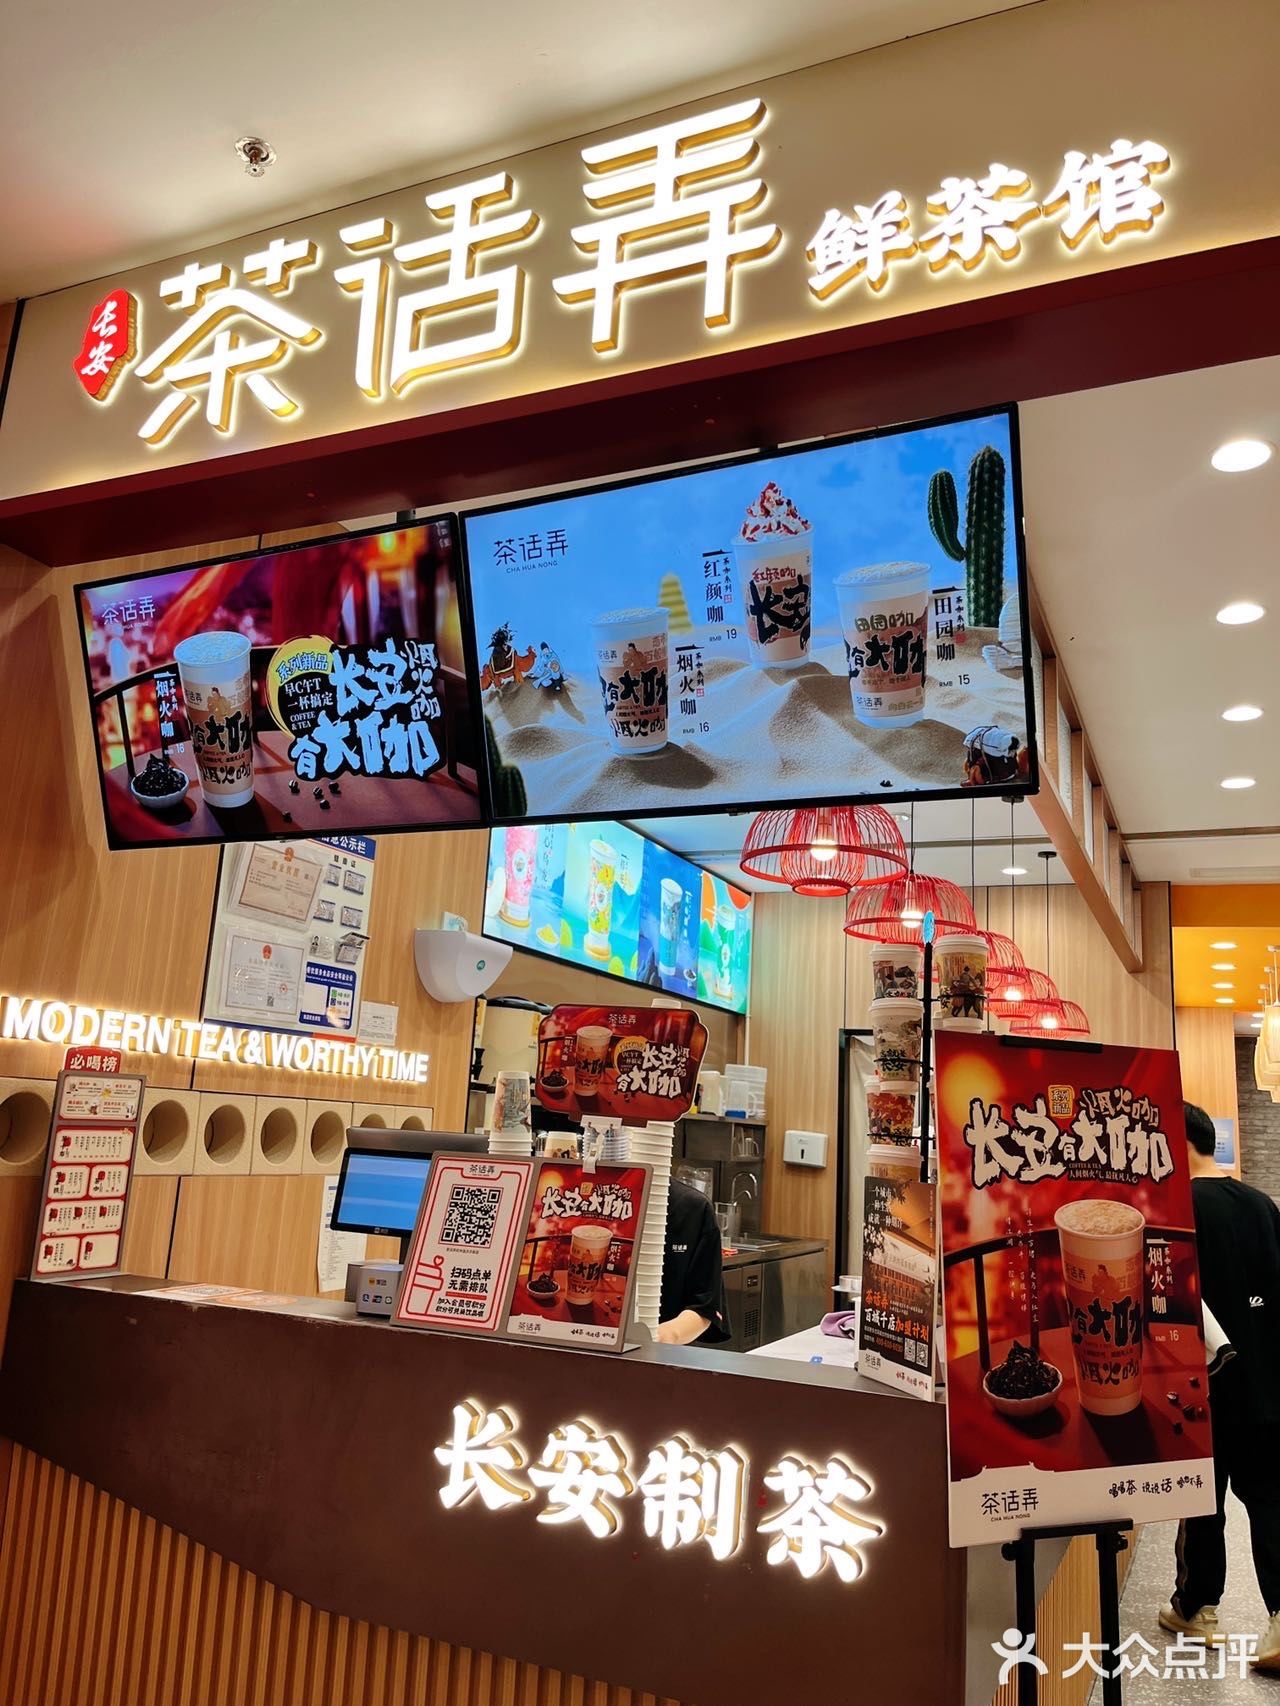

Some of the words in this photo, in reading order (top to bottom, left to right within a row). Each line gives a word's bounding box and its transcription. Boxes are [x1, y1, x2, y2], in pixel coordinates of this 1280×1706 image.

[134, 97, 784, 446] 茶话弄
[806, 137, 1172, 302] 鲜茶馆
[493, 528, 569, 566] 茶话弄
[506, 566, 521, 574] CHA
[538, 560, 558, 569] NONG
[703, 559, 724, 624] 红颜咖
[101, 595, 156, 626] 茶话弄
[726, 628, 737, 640] 19
[934, 596, 956, 662] 田园咖
[275, 651, 329, 684] 系列新品
[285, 677, 322, 698] 早C午T
[676, 653, 697, 716] 烟火咖
[958, 674, 971, 686] 15
[156, 680, 175, 738] 烟火咖
[288, 691, 335, 711] 一杯搞定
[290, 711, 316, 723] COFFEE
[291, 722, 298, 731] &
[299, 720, 312, 730] TEA
[698, 721, 710, 734] 16
[1, 996, 173, 1055] MODERN
[177, 1020, 238, 1062] TEA
[242, 1029, 264, 1066] &
[270, 1032, 377, 1078] WORTHY
[379, 1047, 430, 1083] TIME
[69, 1054, 118, 1072] 必喝榜
[450, 1266, 492, 1281] 扫码点单
[1148, 1246, 1167, 1315] 烟火咖
[448, 1279, 489, 1294] 无需排队
[436, 1297, 487, 1310] 加入会员可积分
[864, 1307, 929, 1343] 百城千店加盟计划
[1169, 1330, 1179, 1342] 16
[433, 1397, 887, 1584] 长安制茶
[1109, 1479, 1137, 1498] 喝喝茶
[1142, 1477, 1172, 1494] 说说话
[981, 1487, 1039, 1515] 茶话弄
